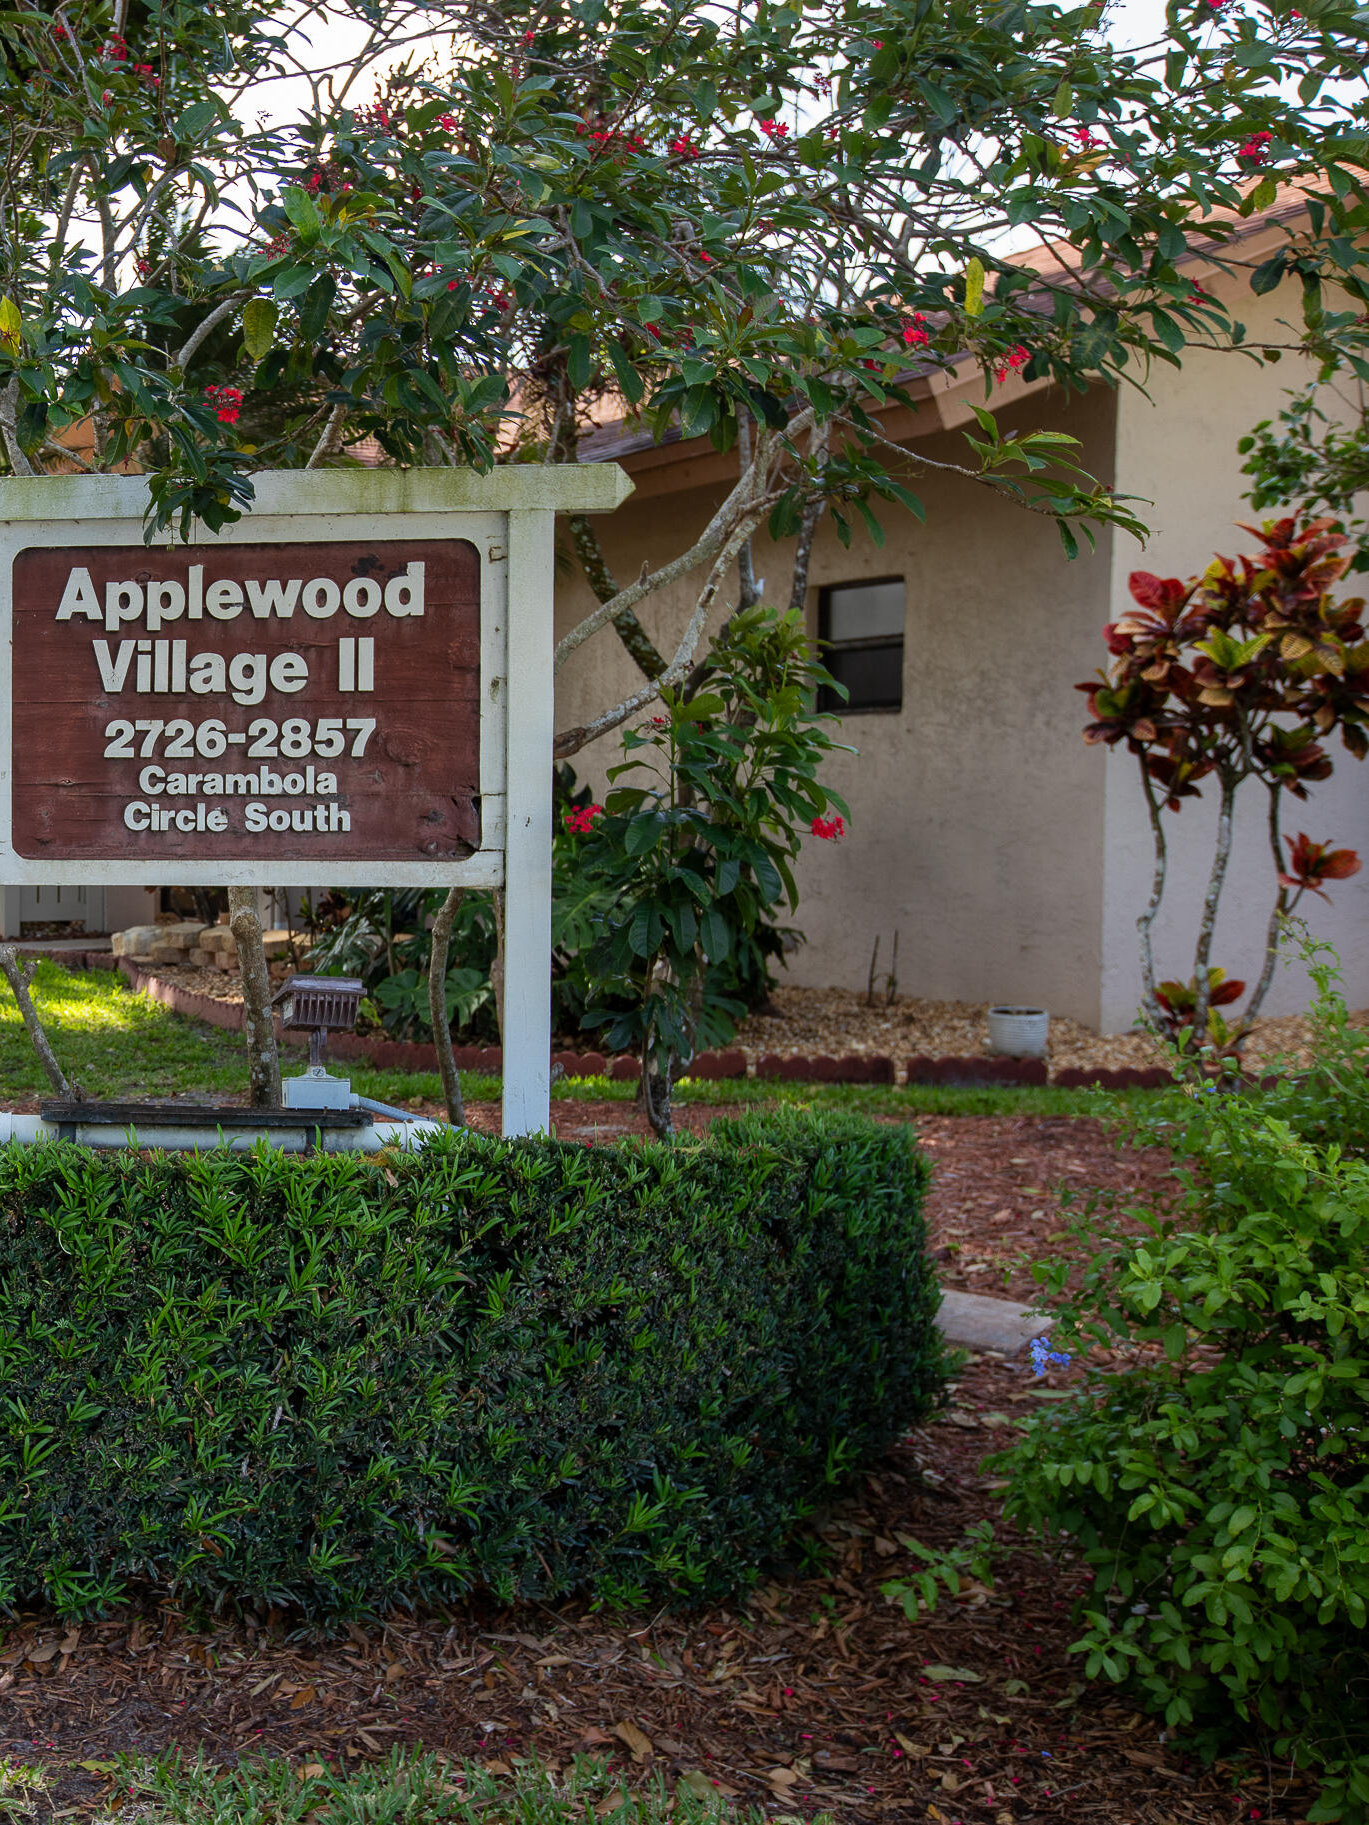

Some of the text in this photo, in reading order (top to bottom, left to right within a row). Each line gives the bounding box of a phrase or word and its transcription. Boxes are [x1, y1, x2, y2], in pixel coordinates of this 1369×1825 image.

[55, 561, 426, 632] Applewood
[93, 638, 309, 706] Village
[103, 718, 376, 759] 2726-2857
[138, 765, 338, 796] Carambola
[123, 801, 352, 833] Circle South
